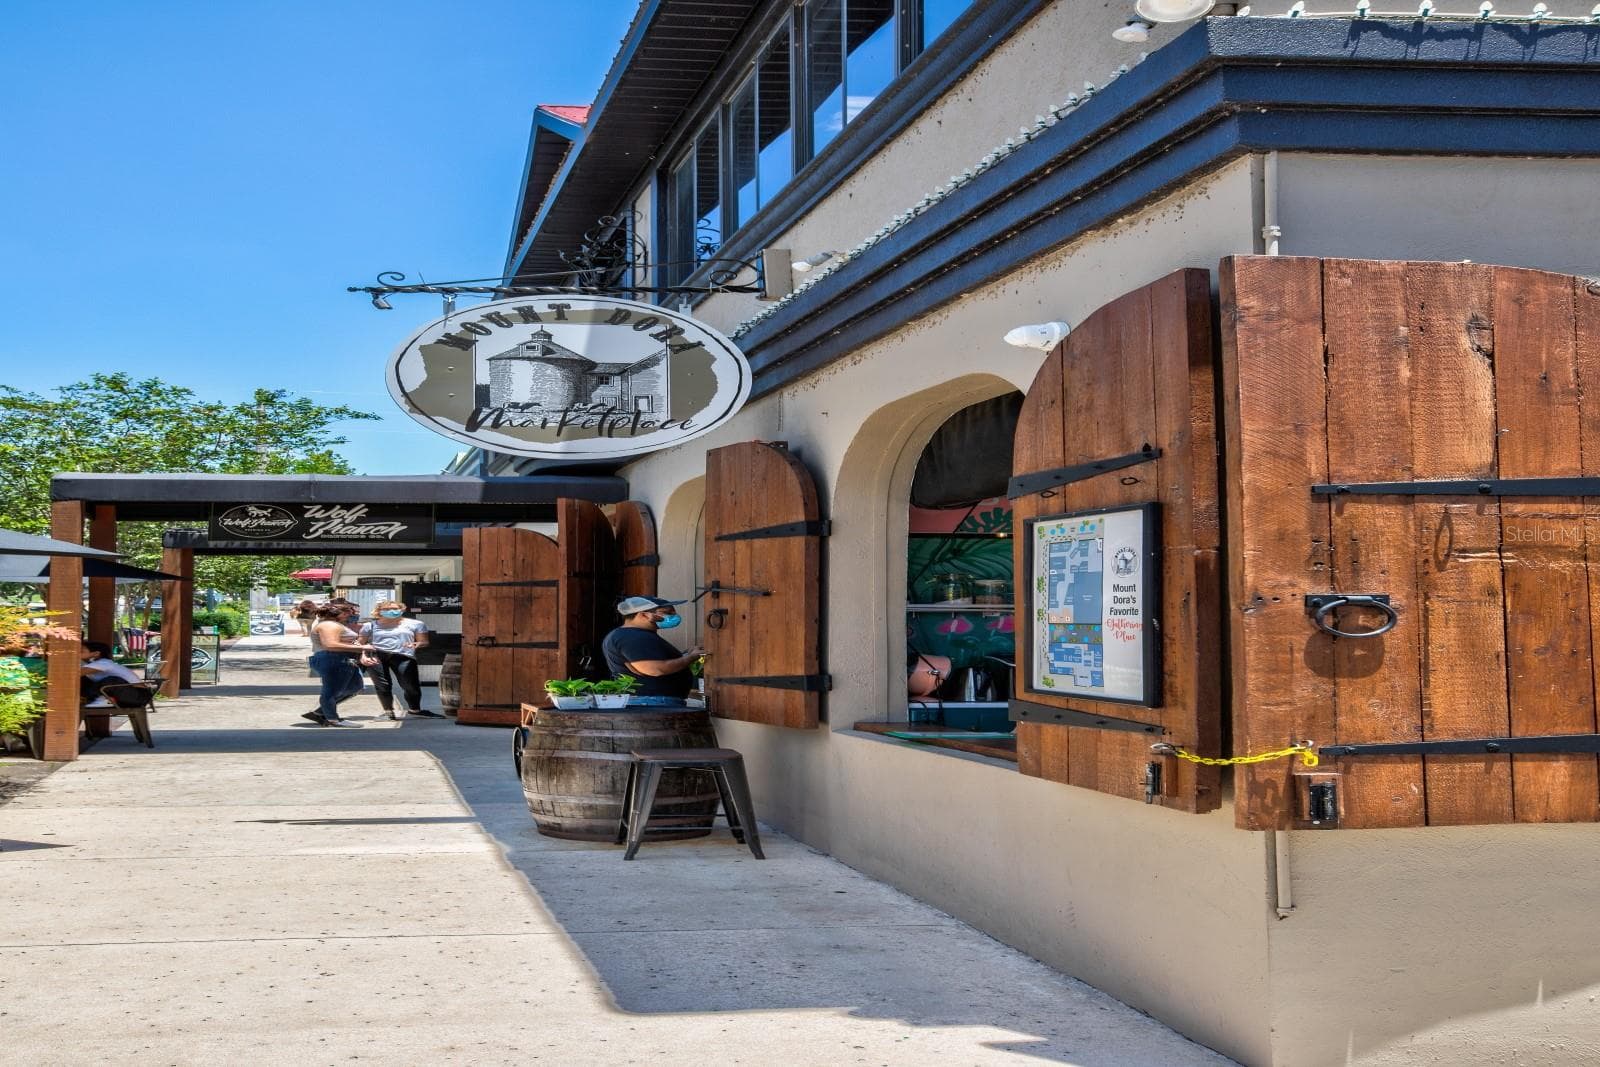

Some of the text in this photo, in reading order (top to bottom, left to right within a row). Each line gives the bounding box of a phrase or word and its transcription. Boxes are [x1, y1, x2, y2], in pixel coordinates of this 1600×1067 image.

[434, 303, 705, 354] MOUNT DORA
[303, 503, 369, 524] Wolf
[302, 518, 408, 540] Branch
[1112, 583, 1137, 593] Mount
[1113, 595, 1137, 605] Dora's
[1109, 607, 1139, 616] Favorite
